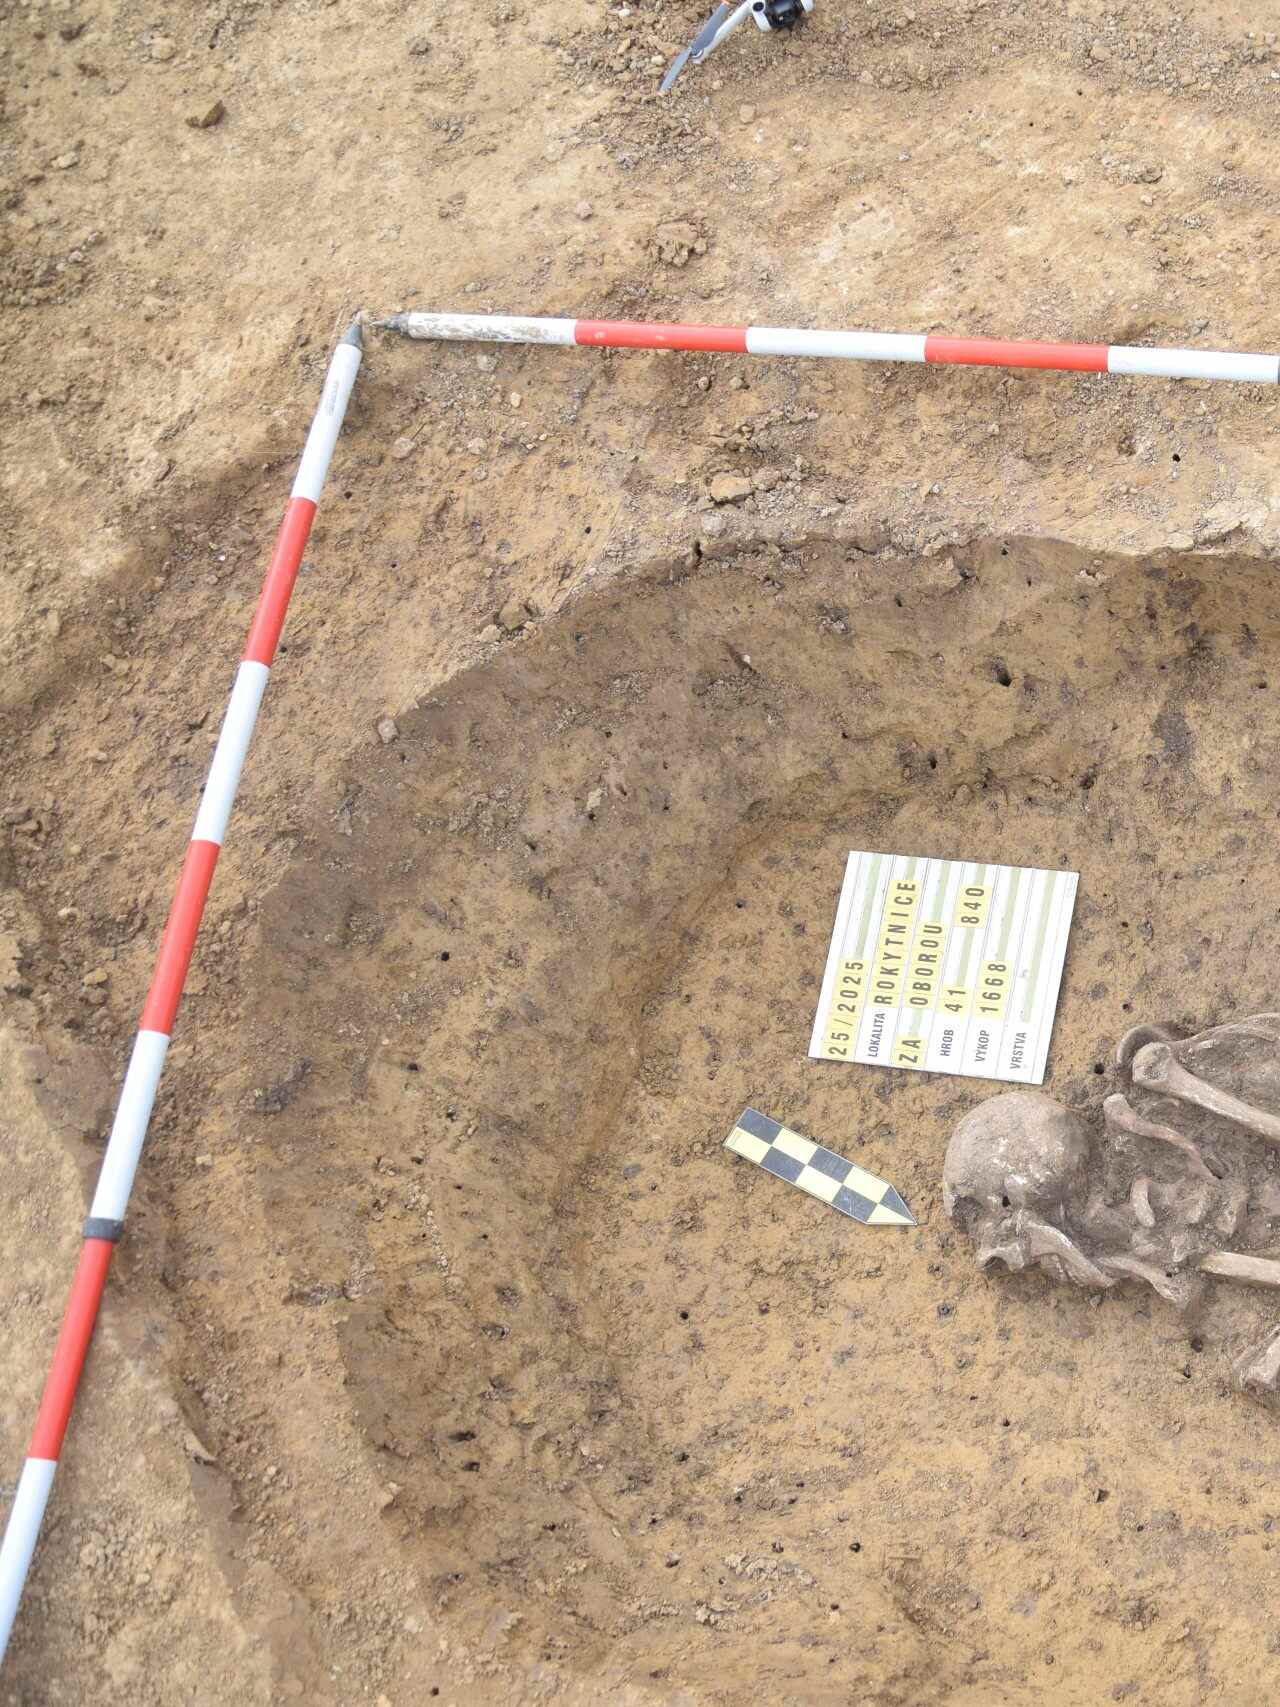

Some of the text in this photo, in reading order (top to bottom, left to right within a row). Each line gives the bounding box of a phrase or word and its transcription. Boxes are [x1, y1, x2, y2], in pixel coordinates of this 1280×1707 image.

[829, 961, 864, 1056] 25/2025
[867, 882, 916, 1057] LOKALITA ROKYTNICE
[898, 924, 943, 1063] ZA OBOROU
[940, 887, 984, 1056] HROB 41 840
[979, 963, 1007, 1013] 1668
[1009, 1031, 1027, 1069] VRSTVA
